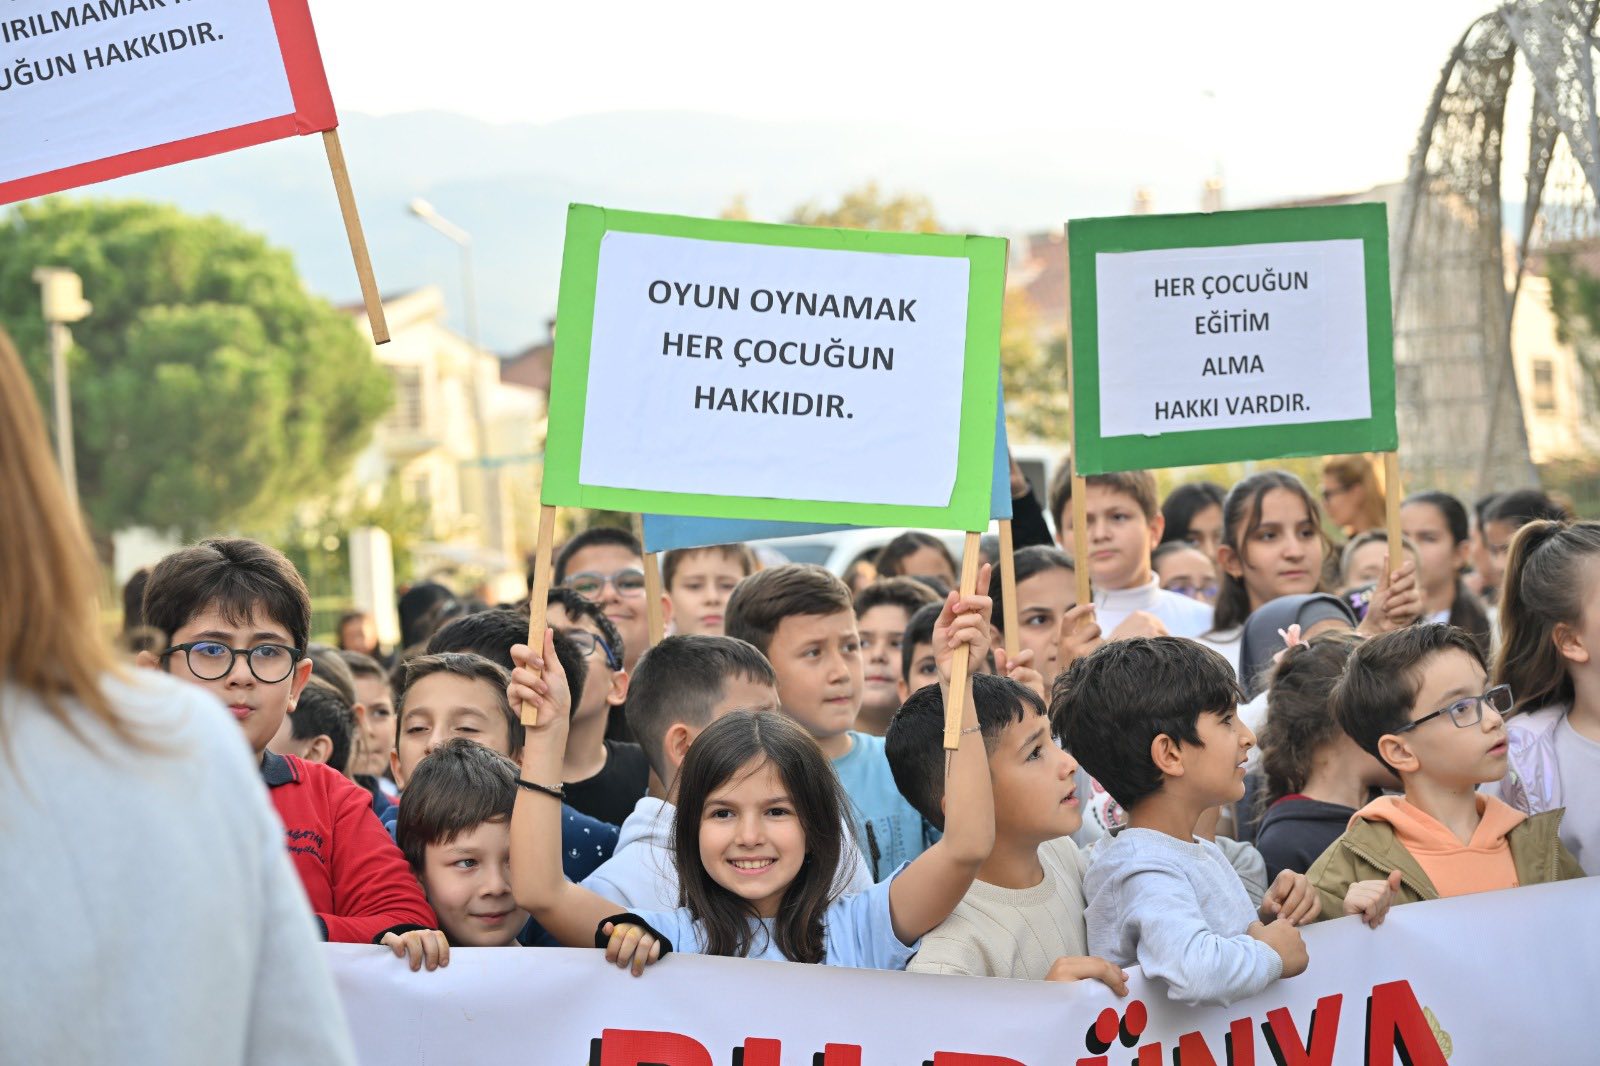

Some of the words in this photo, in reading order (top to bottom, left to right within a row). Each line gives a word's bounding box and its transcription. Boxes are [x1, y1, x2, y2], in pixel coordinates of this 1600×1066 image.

[84, 23, 223, 70] HAKKIDIR.
[1155, 278, 1194, 297] HER
[1202, 268, 1307, 299] ÇOCUĞUN
[649, 281, 739, 310] OYUN
[751, 290, 916, 322] OYNAMAK
[1196, 309, 1268, 334] EĞİTİM
[663, 333, 722, 359] HER
[734, 338, 893, 370] ÇOCUĞUN
[1202, 355, 1264, 376] ALMA
[695, 386, 852, 418] HAKKIDIR.
[1156, 399, 1217, 419] HAKKI
[1226, 394, 1309, 415] VARDIR.
